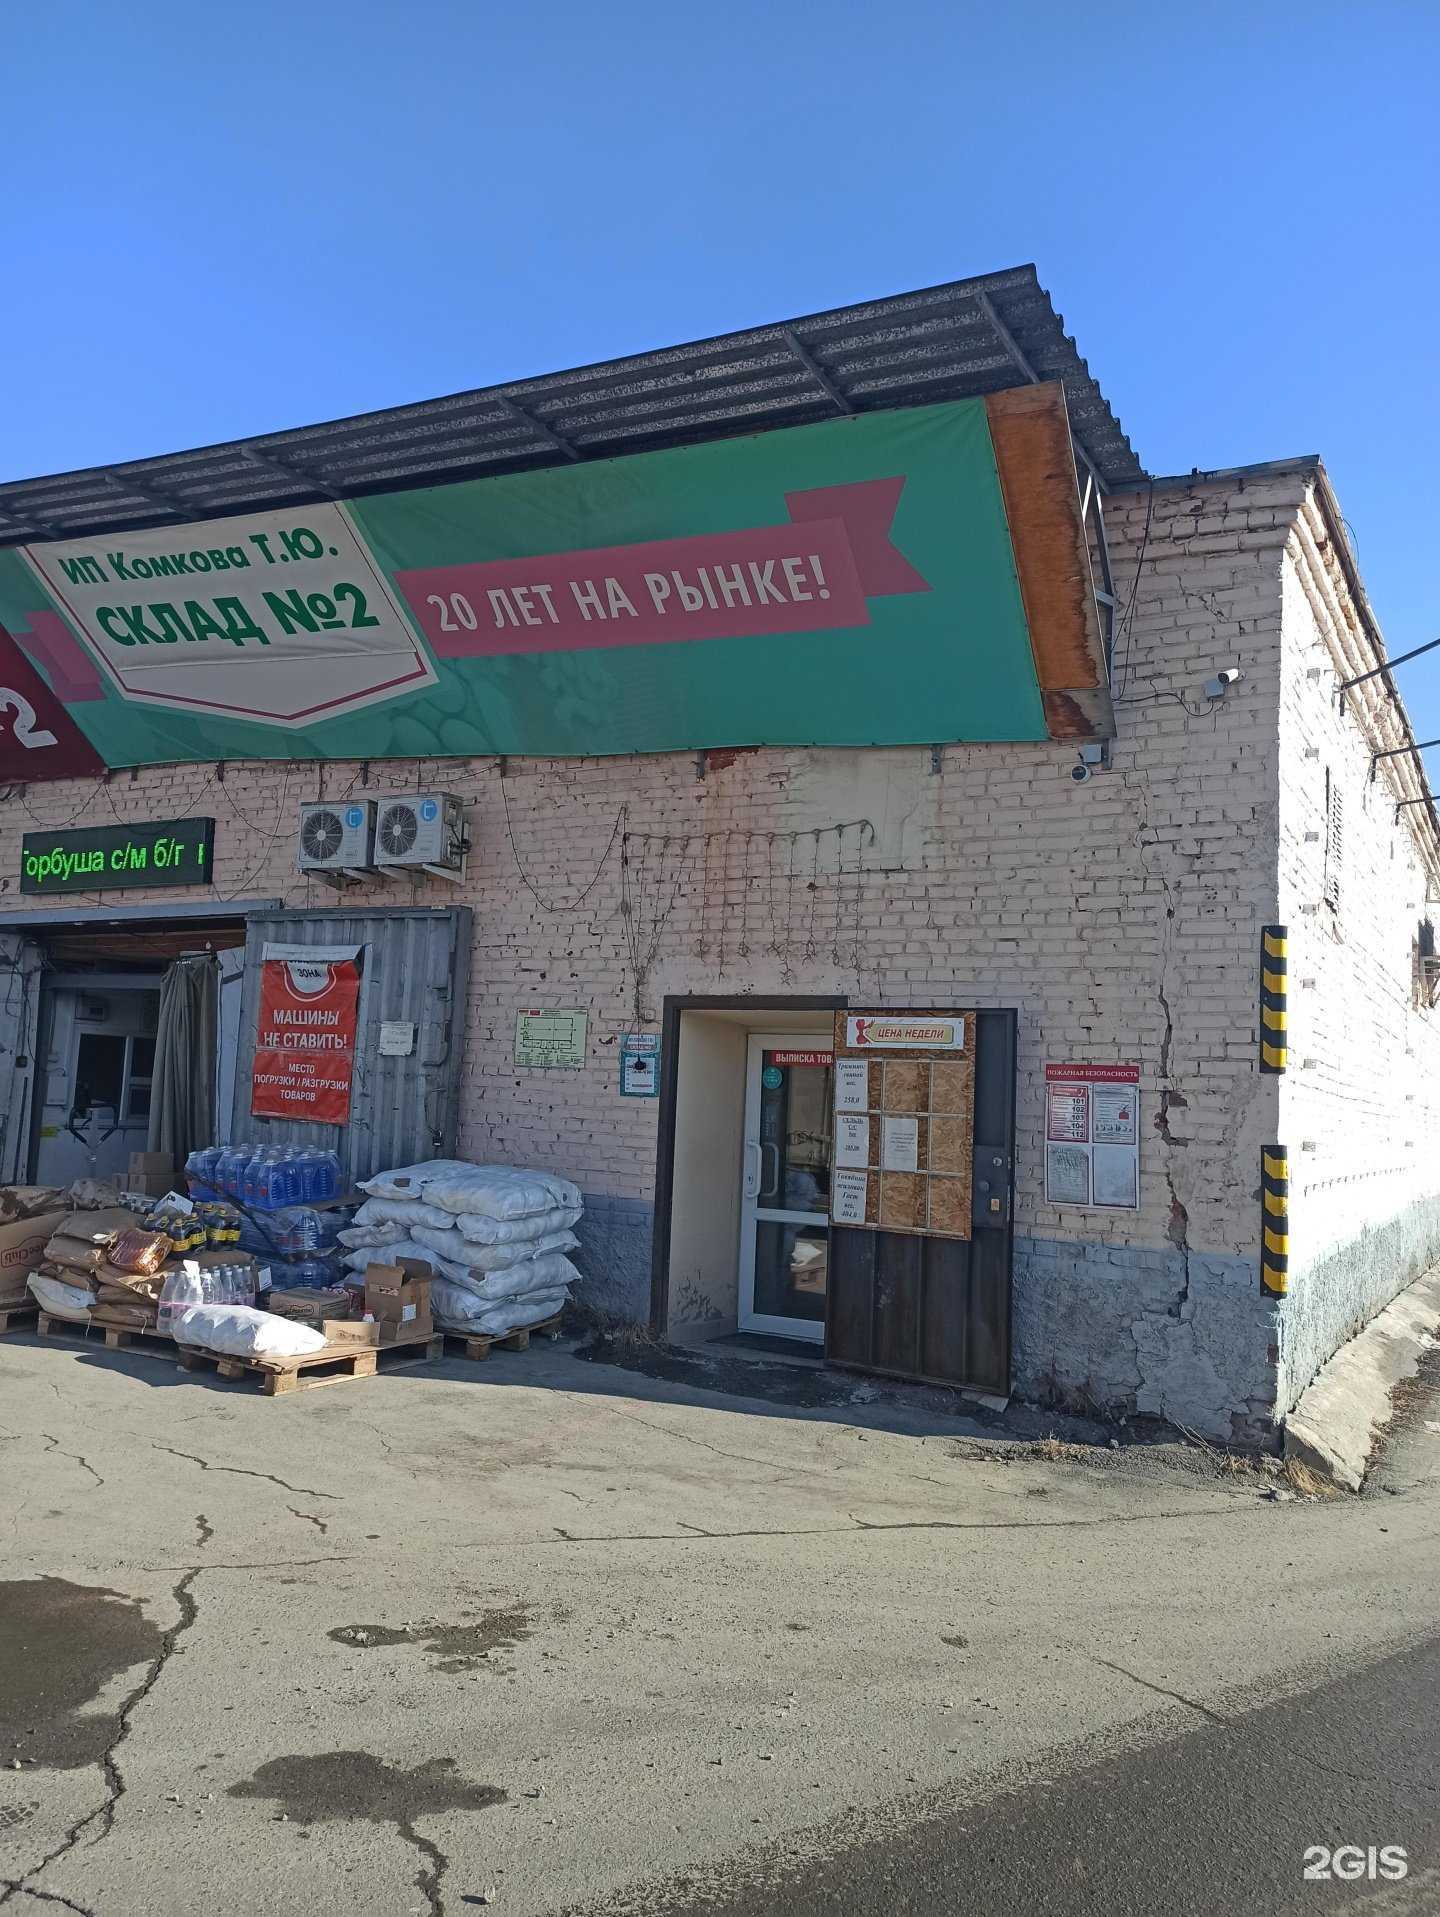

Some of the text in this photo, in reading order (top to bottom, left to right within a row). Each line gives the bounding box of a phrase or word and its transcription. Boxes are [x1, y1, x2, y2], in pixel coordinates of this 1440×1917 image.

[58, 527, 339, 585] ИП Комкова Т.Ю.
[427, 554, 831, 632] 20 ЛЕТ НА РЫНКЕ!
[96, 582, 381, 646] СКЛАД №2
[24, 846, 104, 882] орбуша
[111, 841, 147, 870] с/м
[153, 838, 185, 867] б/г
[273, 1009, 340, 1026] МАШИНЫ
[264, 1031, 348, 1049] НЕ СТАВИТЬ!
[878, 1027, 945, 1040] ЦЕНА НЕДЕЛИ
[775, 1053, 834, 1063] ВЫПИСКА ТОВ
[288, 1063, 315, 1073] МЕСТО
[254, 1074, 295, 1087] ПОГРУЗКИ
[301, 1077, 349, 1091] РАЗГРУЗКИ
[280, 1089, 316, 1101] ТОВАРОВ
